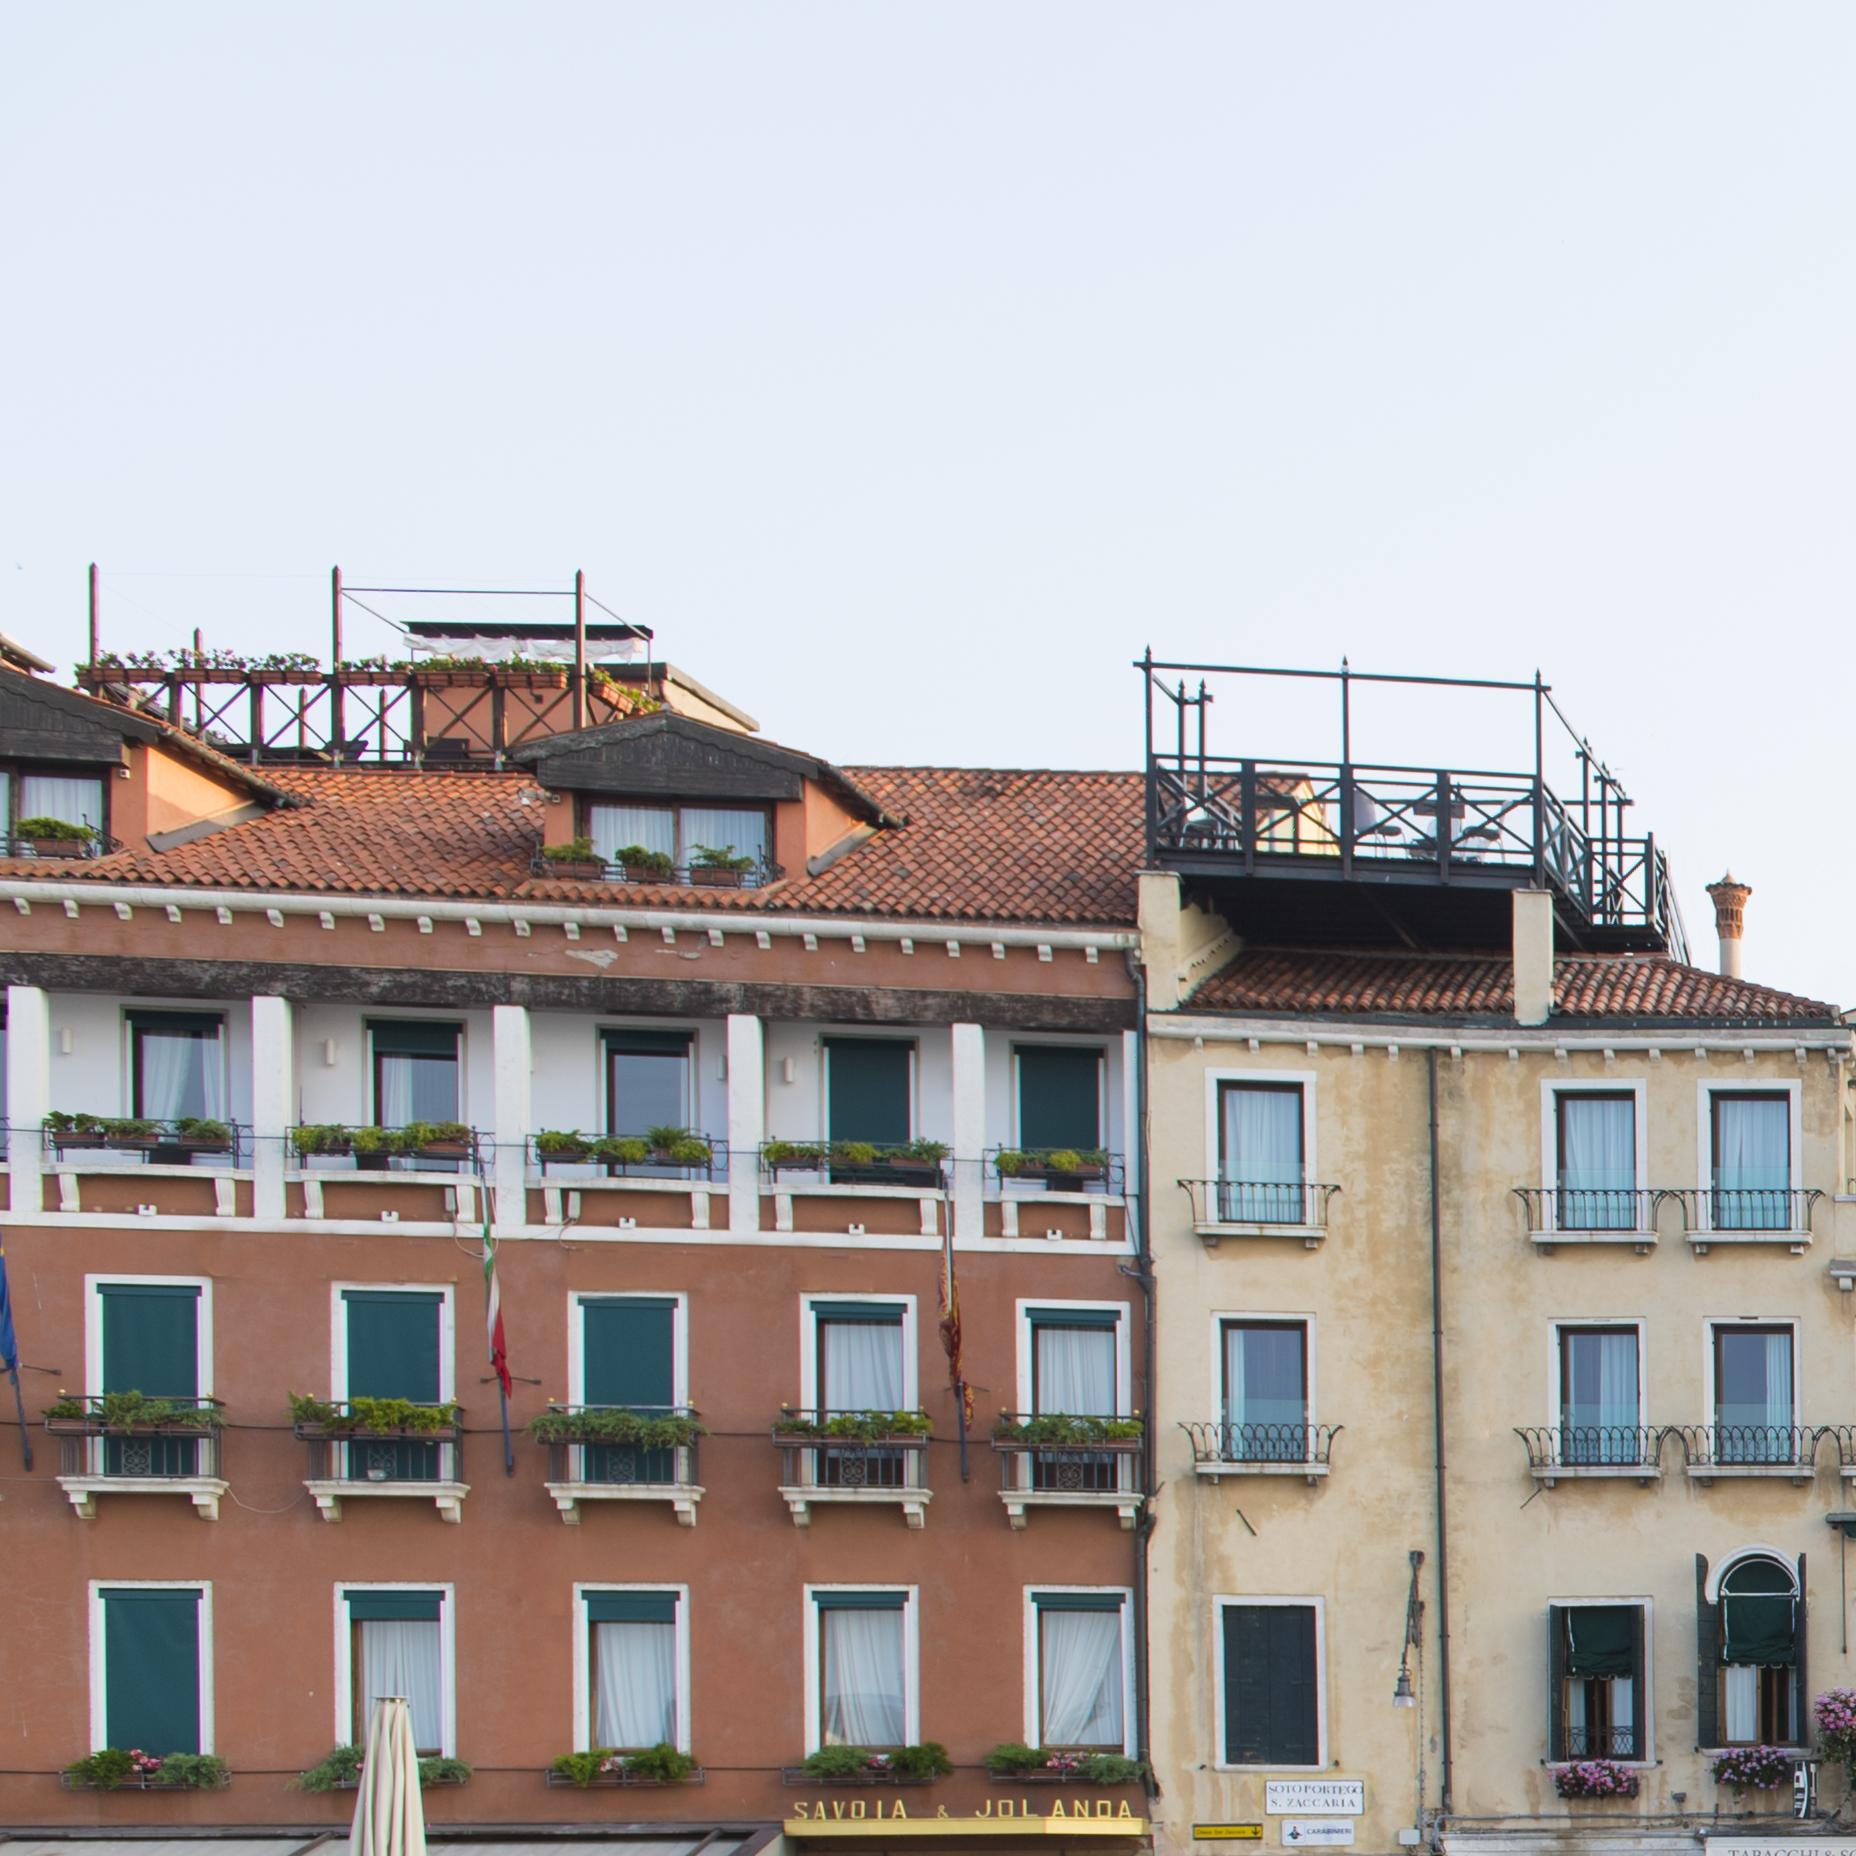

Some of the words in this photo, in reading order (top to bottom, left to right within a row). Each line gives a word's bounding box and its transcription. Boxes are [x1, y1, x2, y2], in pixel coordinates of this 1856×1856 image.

[794, 1800, 907, 1820] SAVOIA
[937, 1804, 950, 1819] &
[975, 1799, 1133, 1818] JOLANDA
[1287, 1799, 1356, 1808] ZACCARIA
